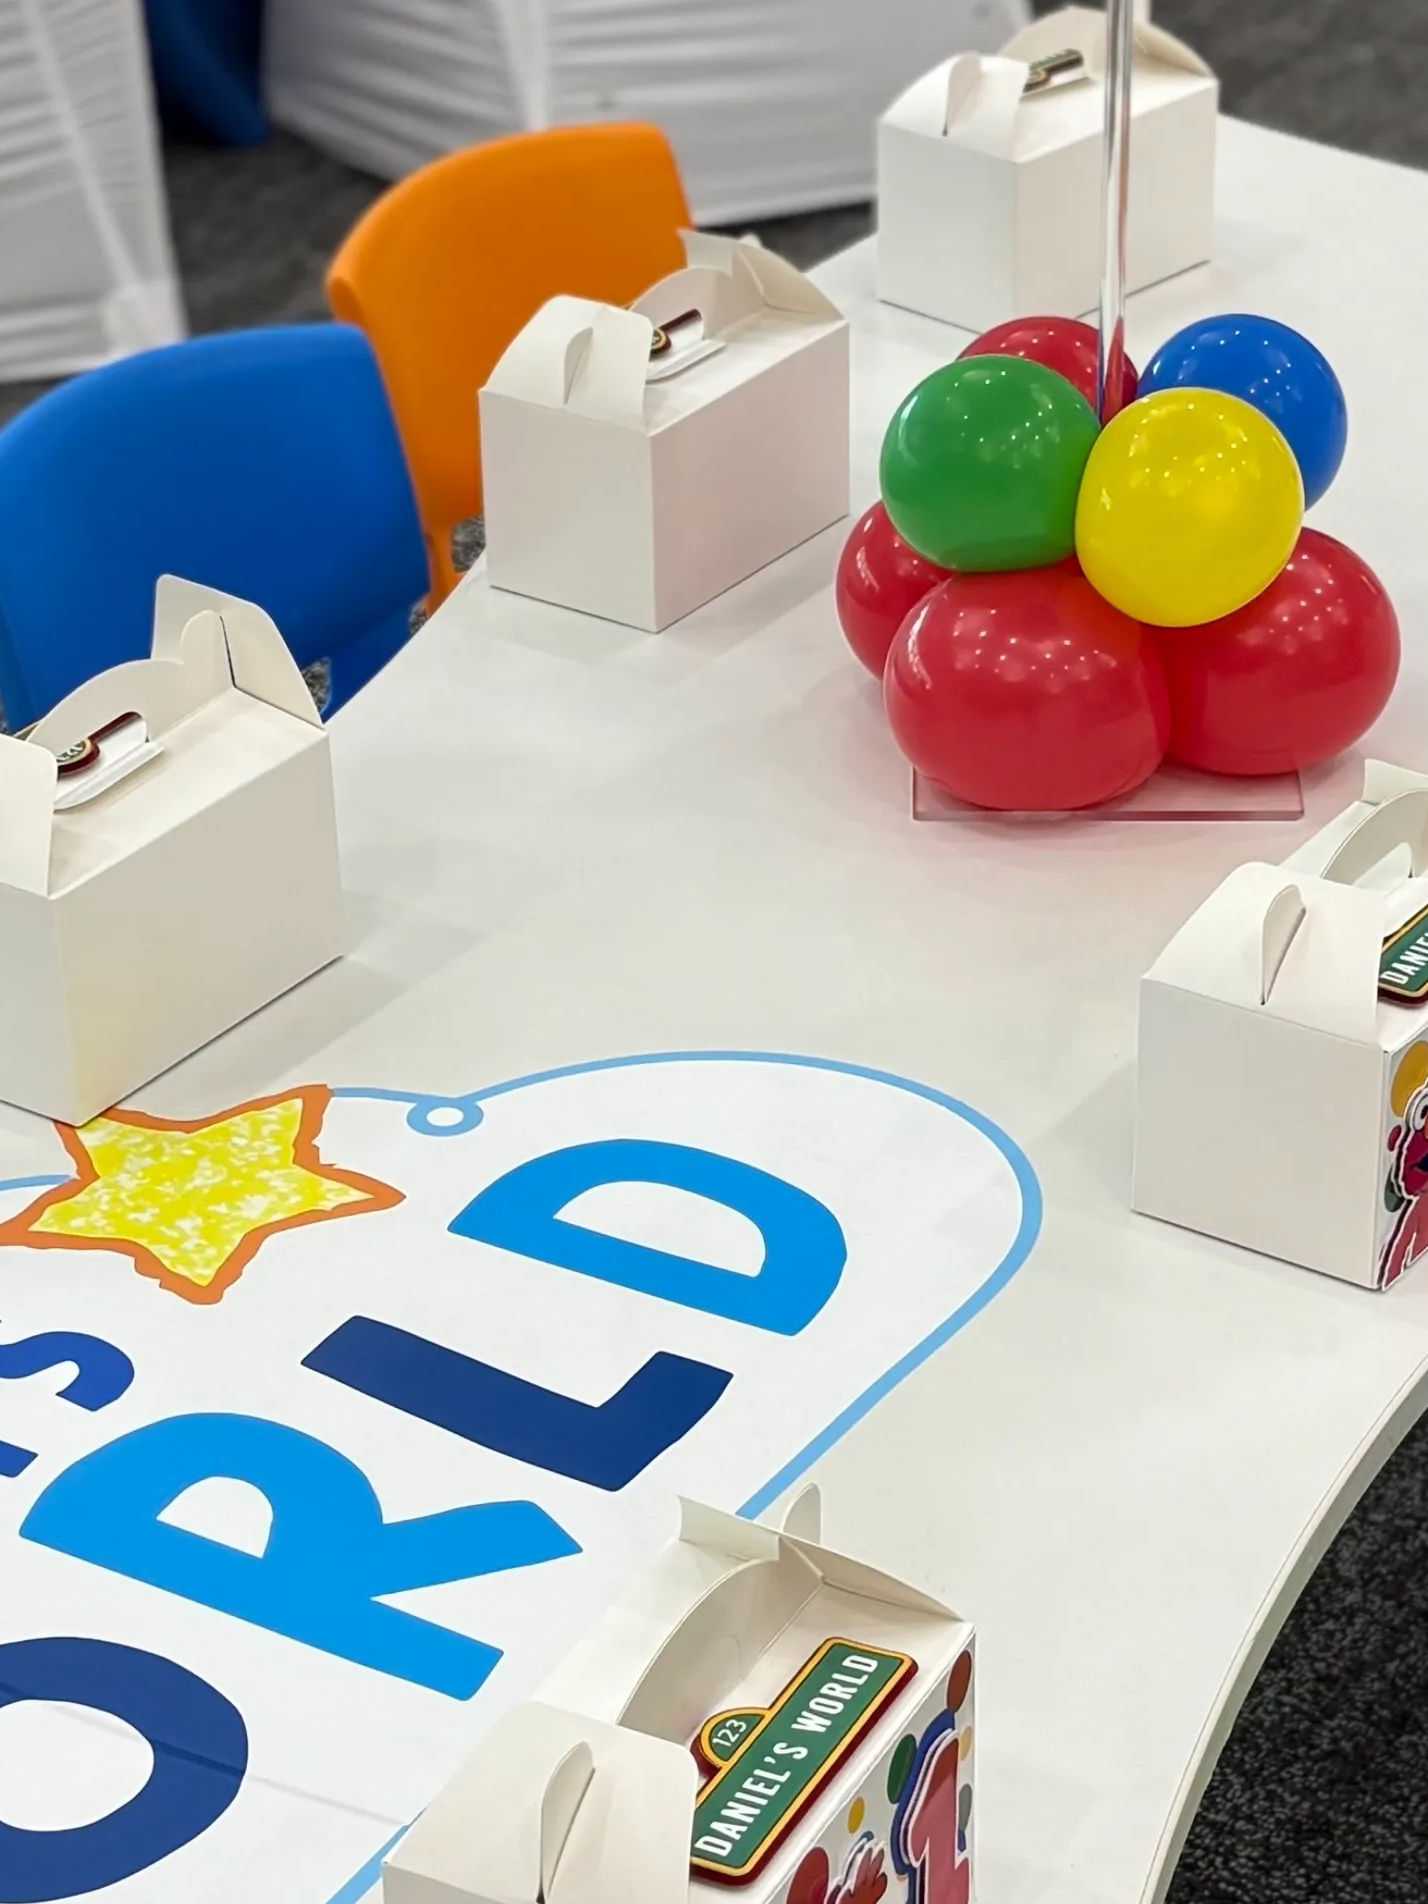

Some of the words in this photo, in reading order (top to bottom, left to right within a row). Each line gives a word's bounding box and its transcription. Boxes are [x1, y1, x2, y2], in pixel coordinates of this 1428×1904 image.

[694, 1742, 808, 1857] DANIEL'S
[791, 1654, 879, 1734] WORLD
[712, 1718, 748, 1748] 123
